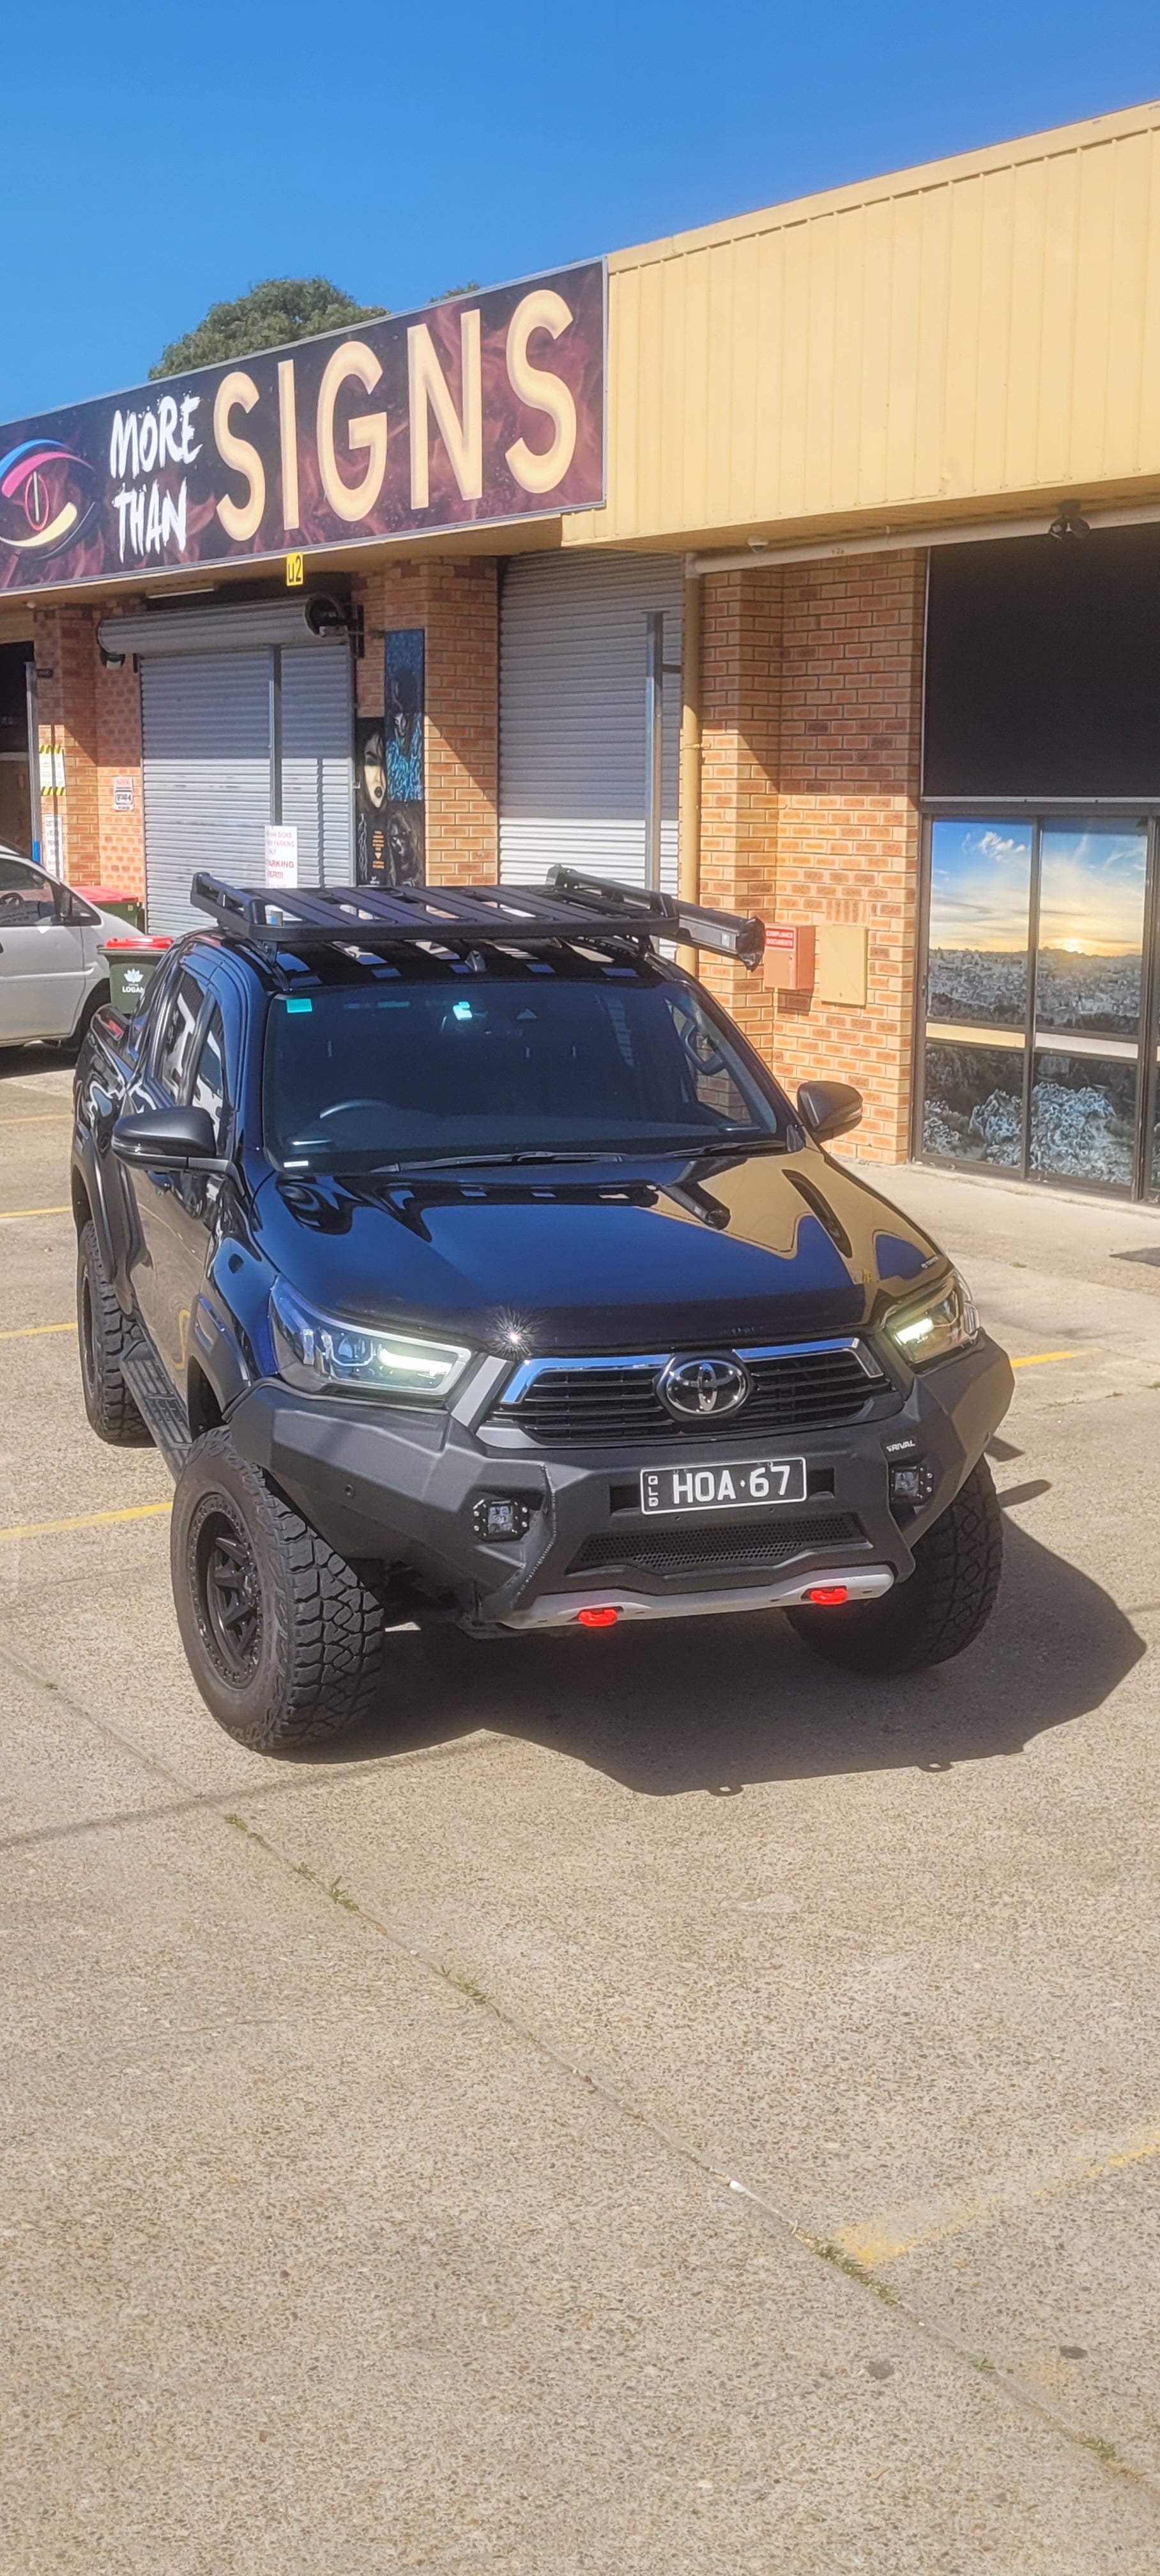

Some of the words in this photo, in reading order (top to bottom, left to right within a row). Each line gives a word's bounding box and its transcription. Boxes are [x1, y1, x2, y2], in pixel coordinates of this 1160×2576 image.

[110, 390, 204, 479] MORE
[213, 289, 577, 540] SIGNS
[111, 477, 187, 564] THAN
[766, 930, 793, 939] COMPLIANCE
[766, 938, 793, 947] DOCUMENTS
[892, 1440, 915, 1452] RIVAL
